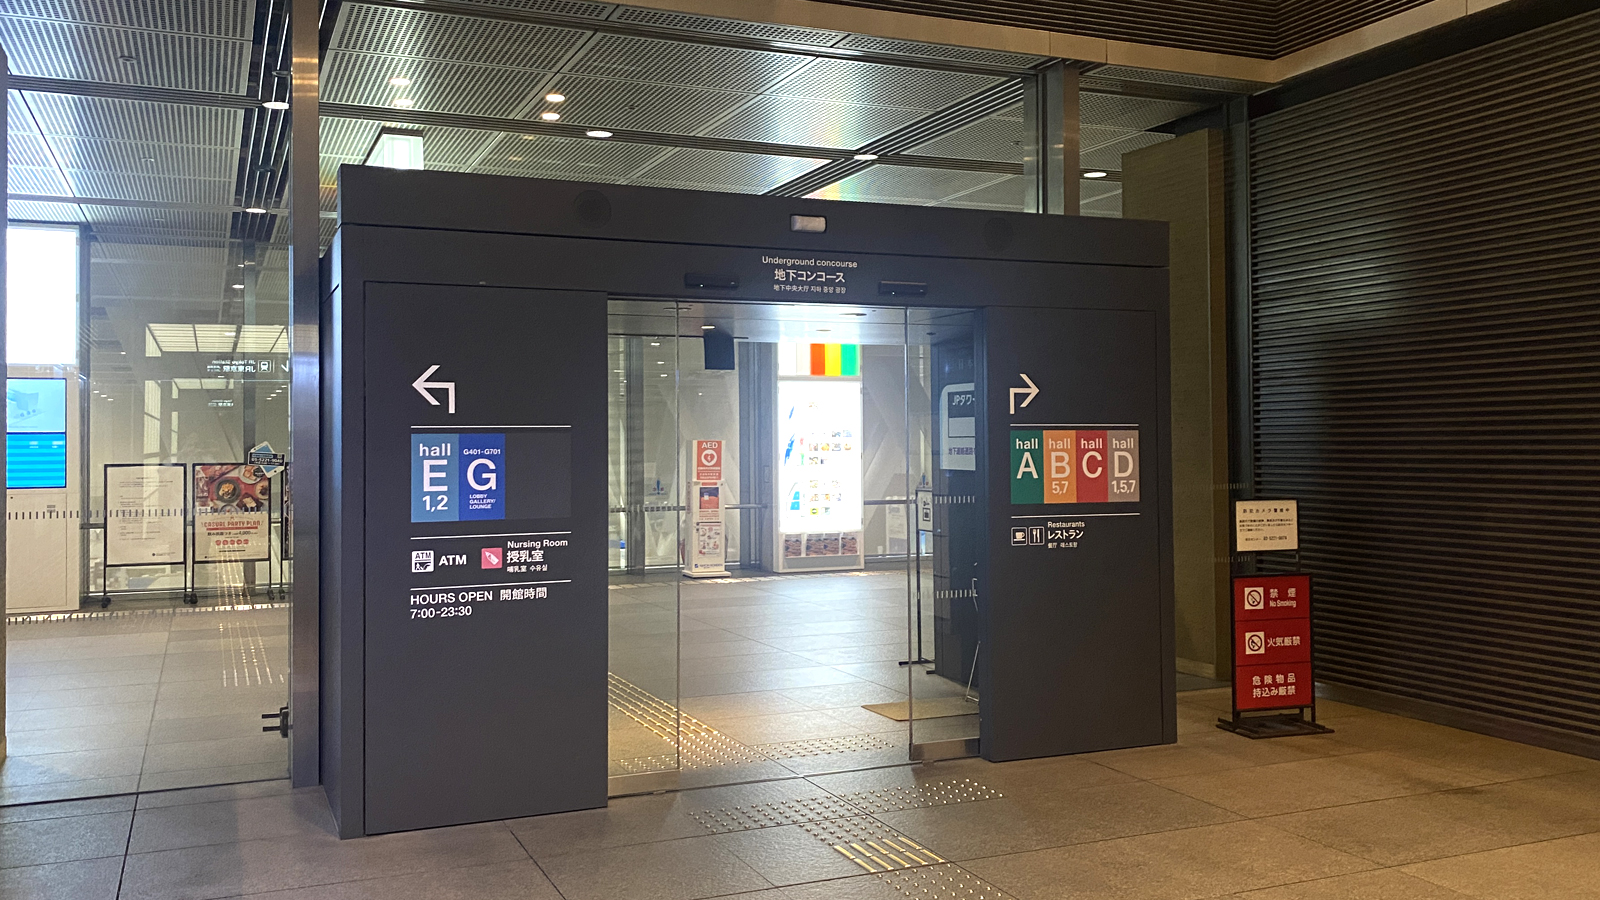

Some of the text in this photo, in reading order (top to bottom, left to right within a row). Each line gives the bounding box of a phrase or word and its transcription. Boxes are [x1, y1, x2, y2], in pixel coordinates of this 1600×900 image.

[762, 256, 858, 267] Underground concourse
[774, 268, 846, 283] 地下コンコース
[952, 394, 975, 406] JPタワ
[420, 443, 451, 456] hall
[1016, 438, 1134, 450] hall hall hall hall
[1016, 451, 1133, 479] A B C D
[423, 458, 497, 492] E G
[1052, 482, 1068, 494] 5,7
[1112, 480, 1136, 493] 1,5,7
[422, 494, 448, 512] 1,2
[1048, 530, 1084, 540] レストラン
[507, 540, 540, 549] Nursing
[415, 552, 431, 560] ATM
[439, 554, 467, 566] ATM
[506, 550, 544, 563] 授乳室
[410, 587, 548, 605] HOURS OPEN 開館時間
[1277, 600, 1297, 608] Smoking
[410, 606, 472, 620] 7:00-23:30
[1267, 636, 1301, 648] 火気厳禁
[1252, 673, 1296, 685] 危険物品
[1253, 686, 1296, 698] 持込み厳禁
